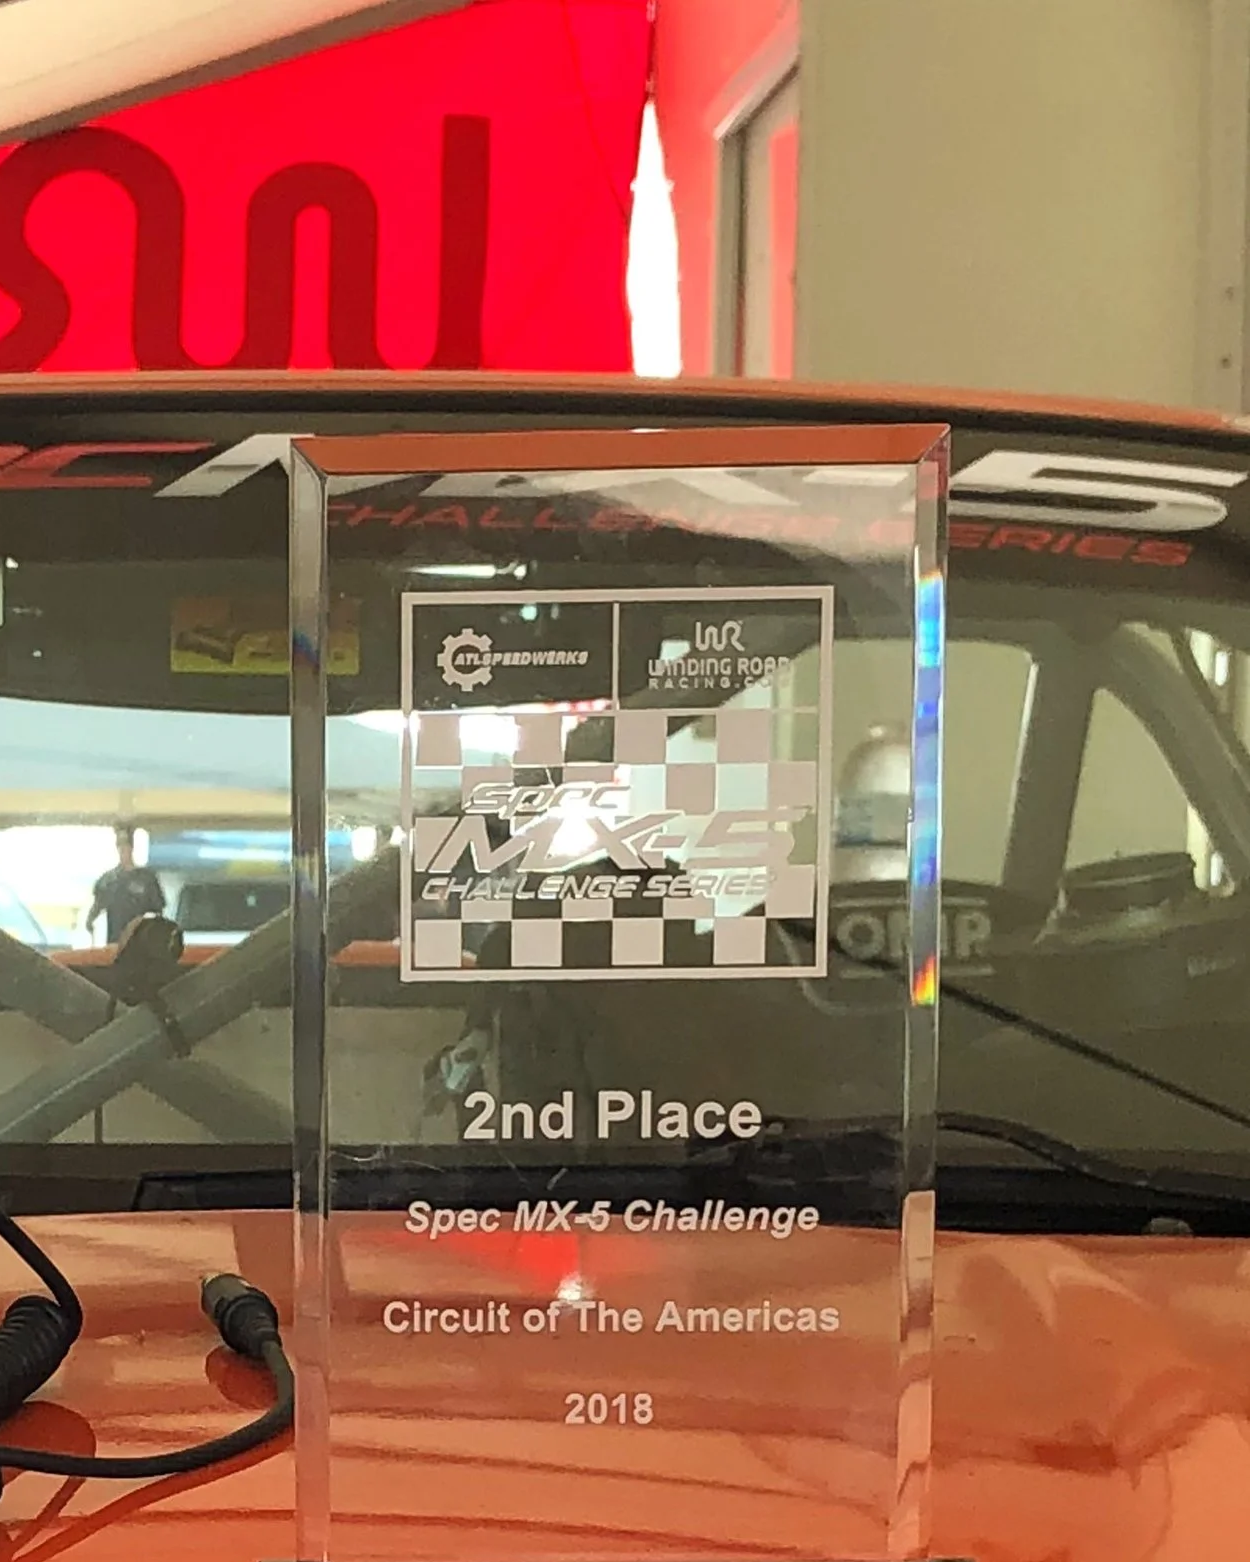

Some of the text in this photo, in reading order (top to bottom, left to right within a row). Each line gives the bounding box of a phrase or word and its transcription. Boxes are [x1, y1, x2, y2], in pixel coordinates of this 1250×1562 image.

[429, 806, 813, 873] MX-5
[421, 873, 774, 901] CHALLENGE SERIES
[463, 1091, 763, 1142] 2nd Place
[405, 1200, 820, 1239] Spec MX-5 Challenge
[382, 1301, 841, 1335] Circuit of The Americas
[563, 1392, 654, 1426] 2018
